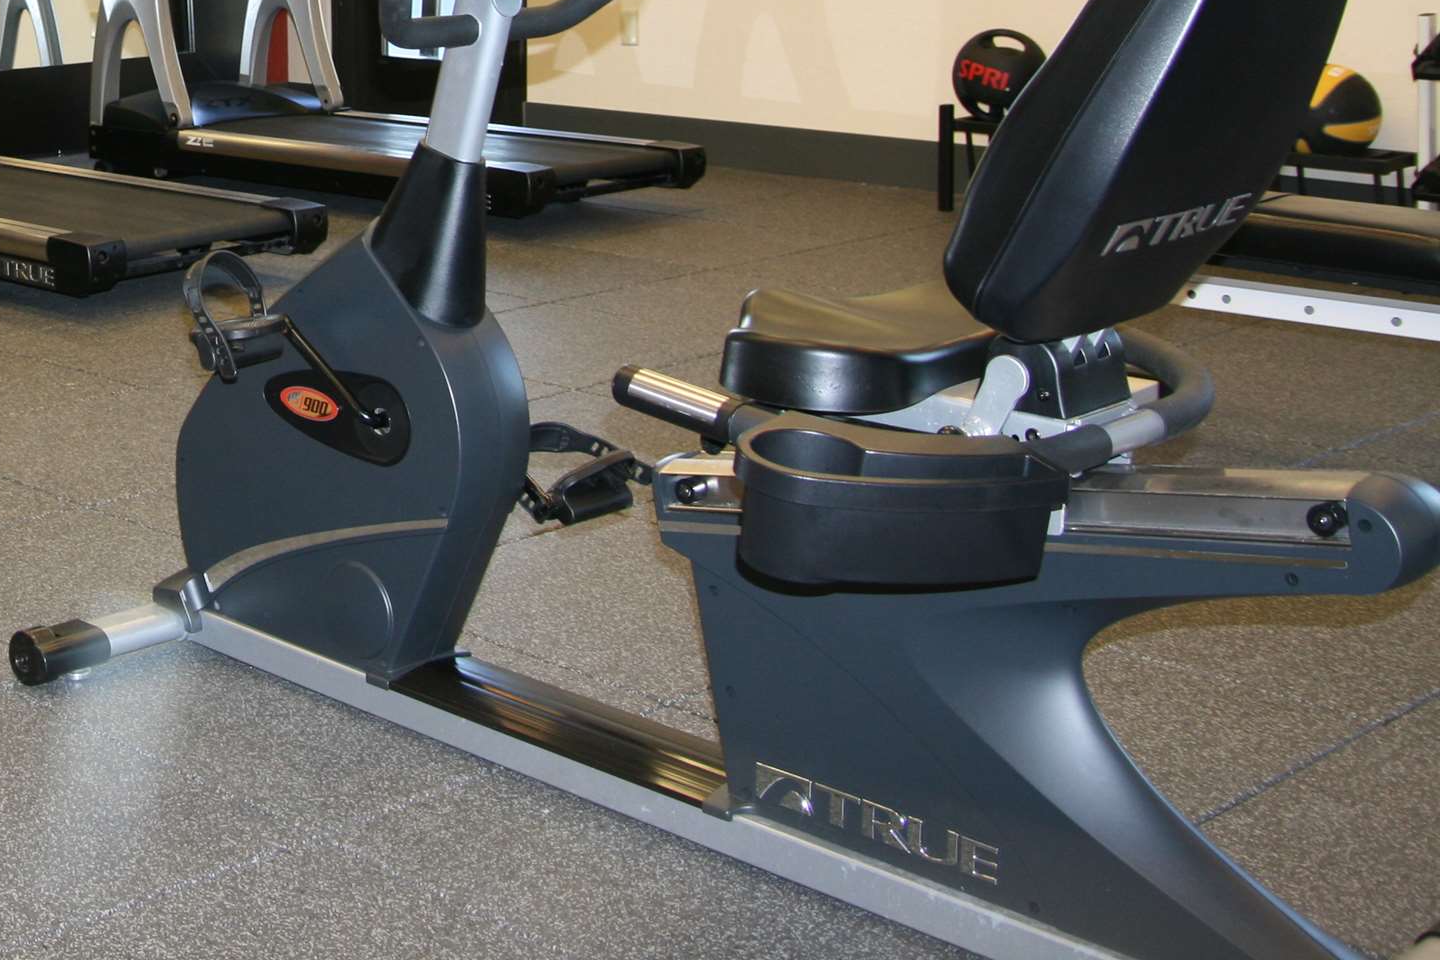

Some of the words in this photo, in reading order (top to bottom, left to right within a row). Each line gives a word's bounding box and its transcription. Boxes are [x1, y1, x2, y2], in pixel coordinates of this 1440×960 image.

[960, 59, 1009, 90] SPRI
[1149, 192, 1252, 246] TRUE
[0, 259, 56, 287] TRUE
[814, 782, 999, 885] TRUE
